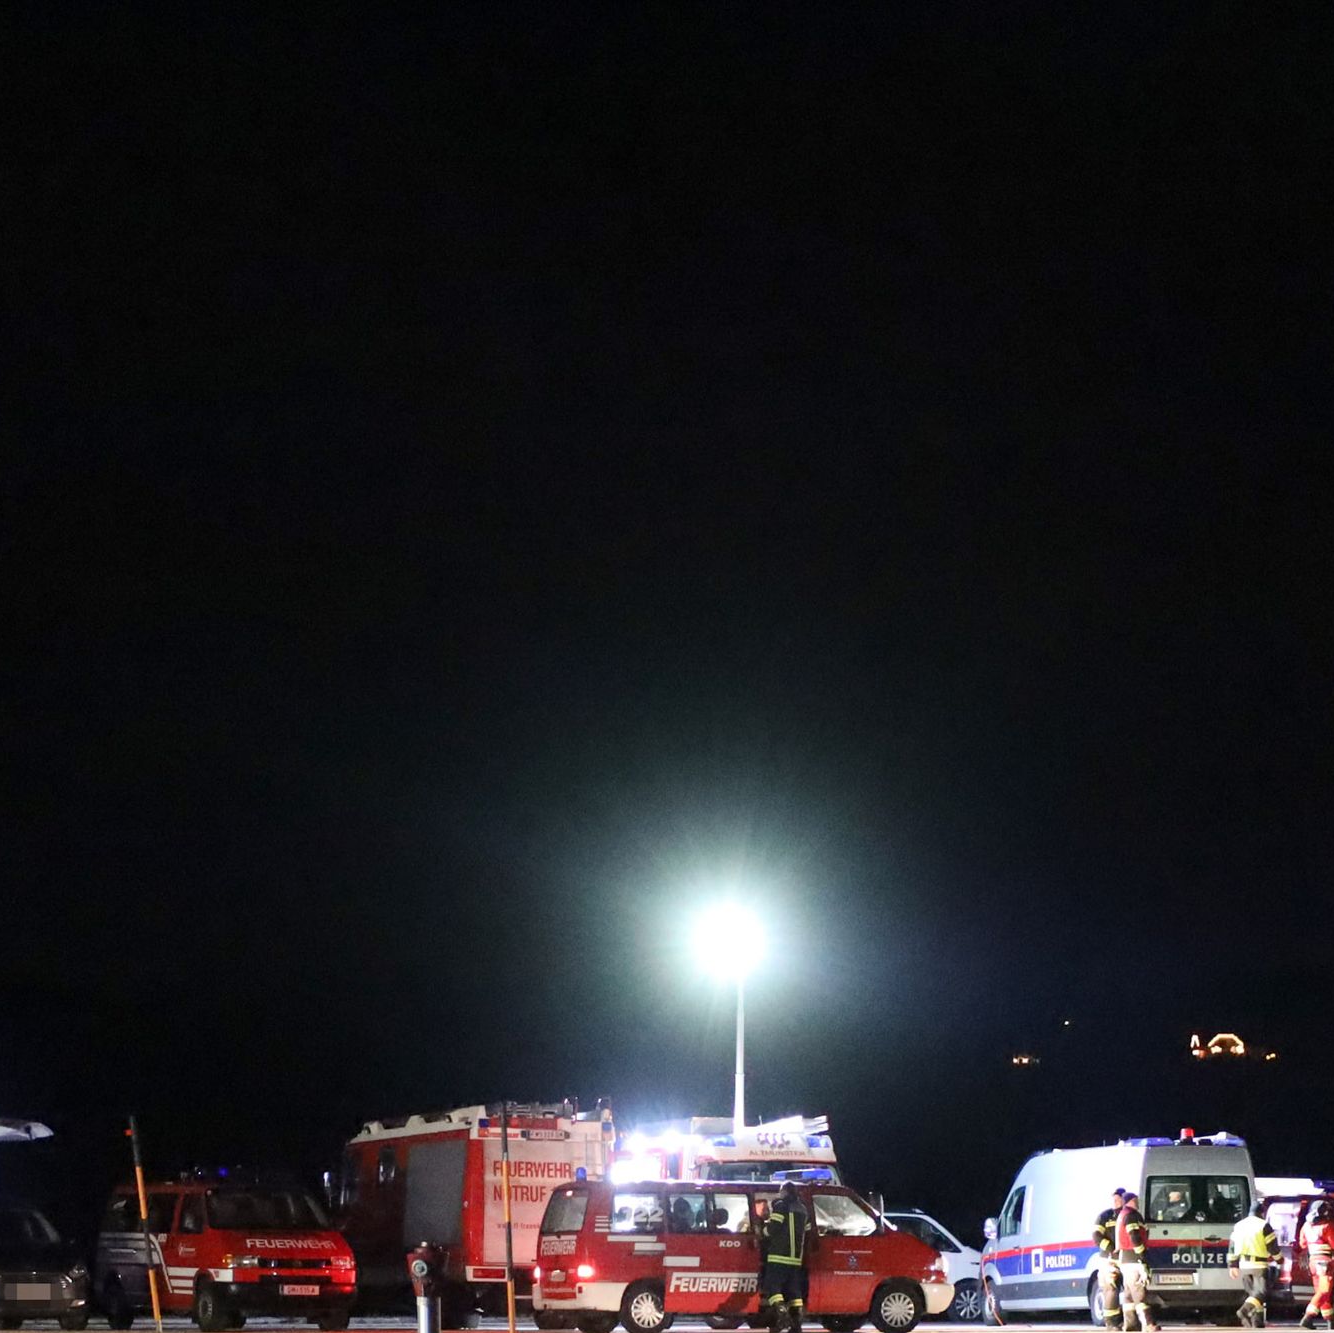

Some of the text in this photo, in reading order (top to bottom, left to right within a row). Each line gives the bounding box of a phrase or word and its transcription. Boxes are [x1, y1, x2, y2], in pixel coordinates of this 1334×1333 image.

[493, 1160, 572, 1178] FUERWEHR
[245, 1238, 335, 1251] FEUERWEHR
[541, 1239, 576, 1256] FEUERWEHR
[719, 1240, 741, 1248] KDO
[1045, 1254, 1072, 1269] POLIZEI
[1172, 1253, 1229, 1264] POLIZE
[669, 1275, 758, 1293] FEUERWEHR
